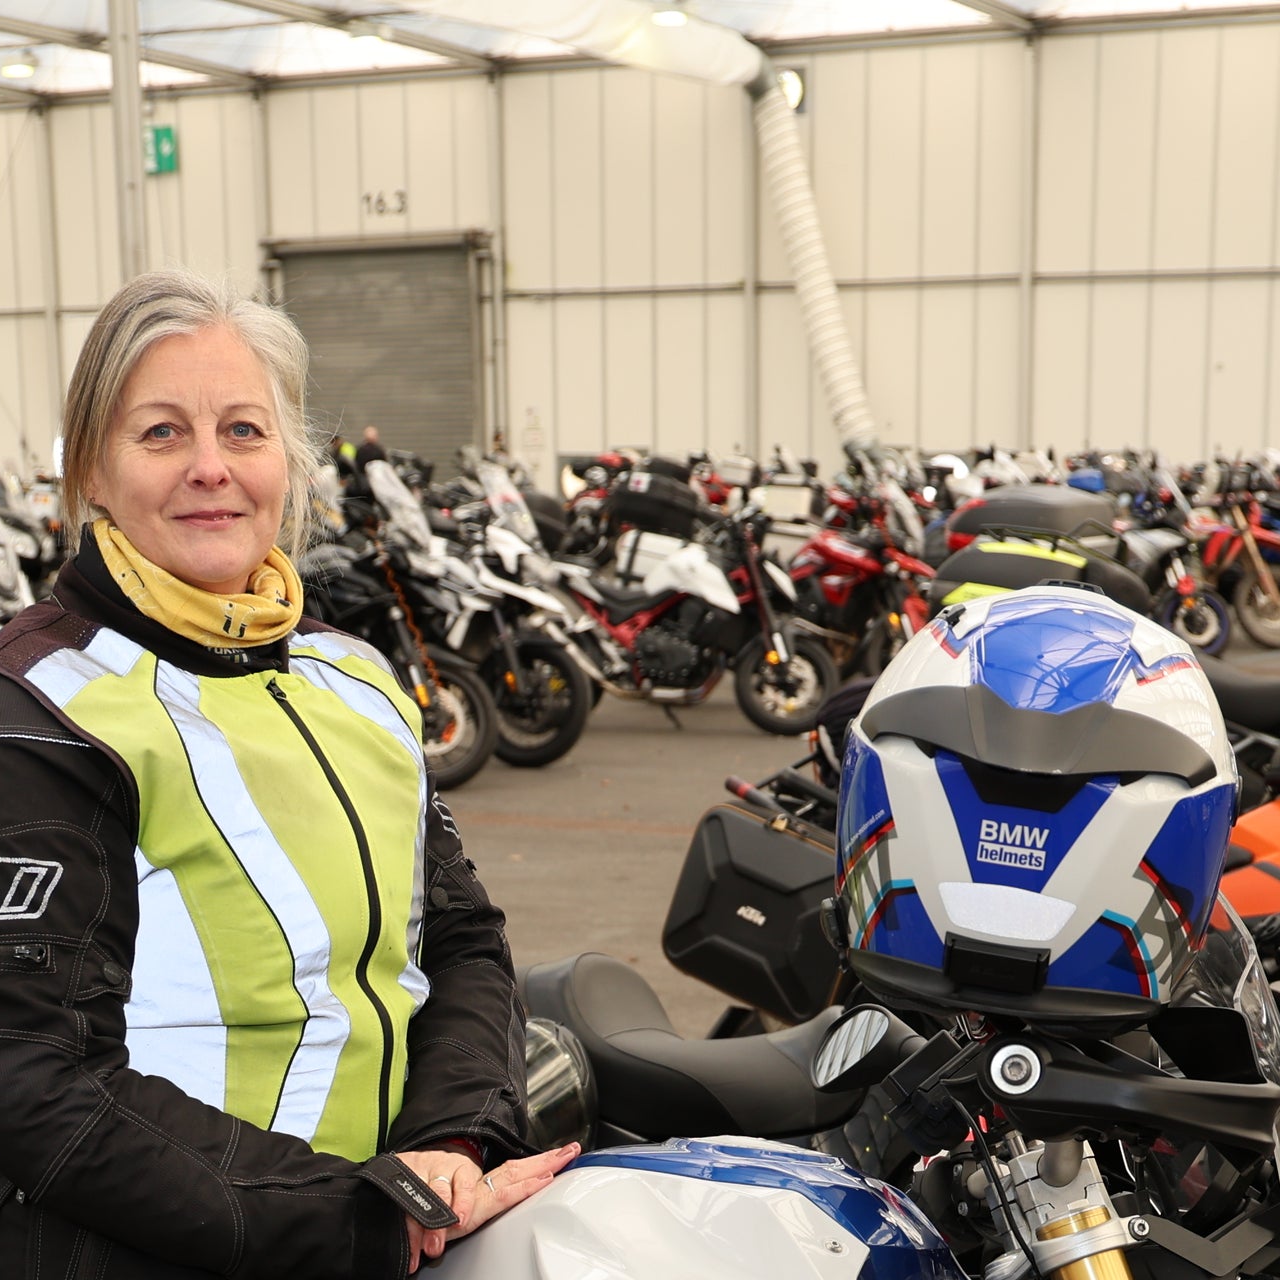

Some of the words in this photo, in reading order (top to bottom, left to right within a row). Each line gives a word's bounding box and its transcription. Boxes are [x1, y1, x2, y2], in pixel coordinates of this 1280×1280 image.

[361, 189, 407, 216] 16.3
[980, 819, 1050, 849] BMW
[979, 844, 1043, 868] helmets
[736, 905, 766, 926] KTM
